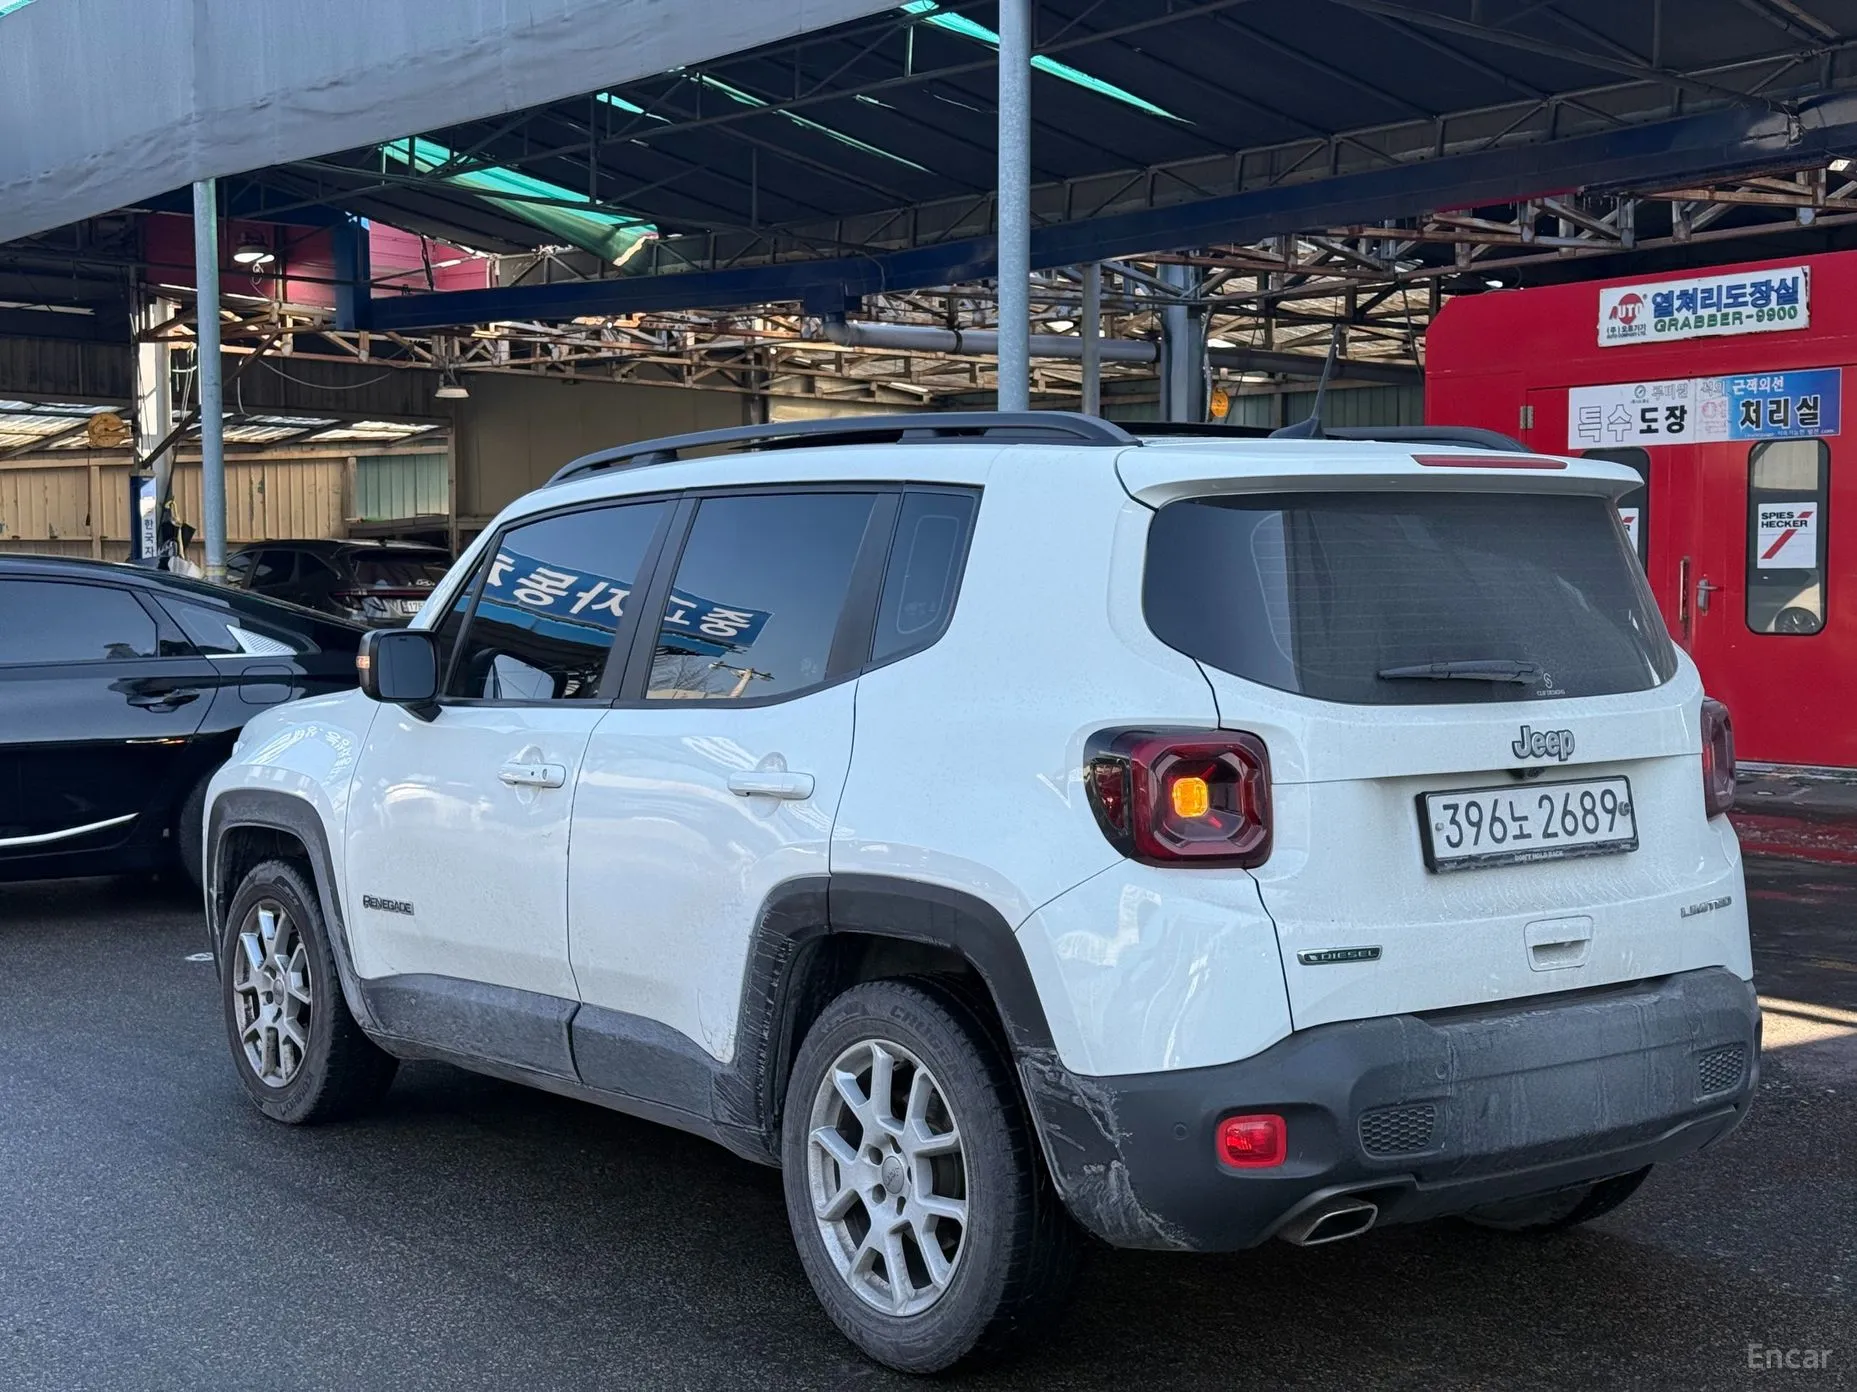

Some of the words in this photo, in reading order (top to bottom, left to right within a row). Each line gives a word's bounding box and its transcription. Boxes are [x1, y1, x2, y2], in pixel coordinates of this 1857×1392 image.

[1654, 305, 1798, 333] GRABBER-9900
[1761, 511, 1794, 520] SPIES
[1761, 519, 1808, 528] HECKER
[1512, 725, 1575, 762] Jeep
[363, 894, 415, 916] RENEGADE
[1321, 949, 1377, 961] DIESEL
